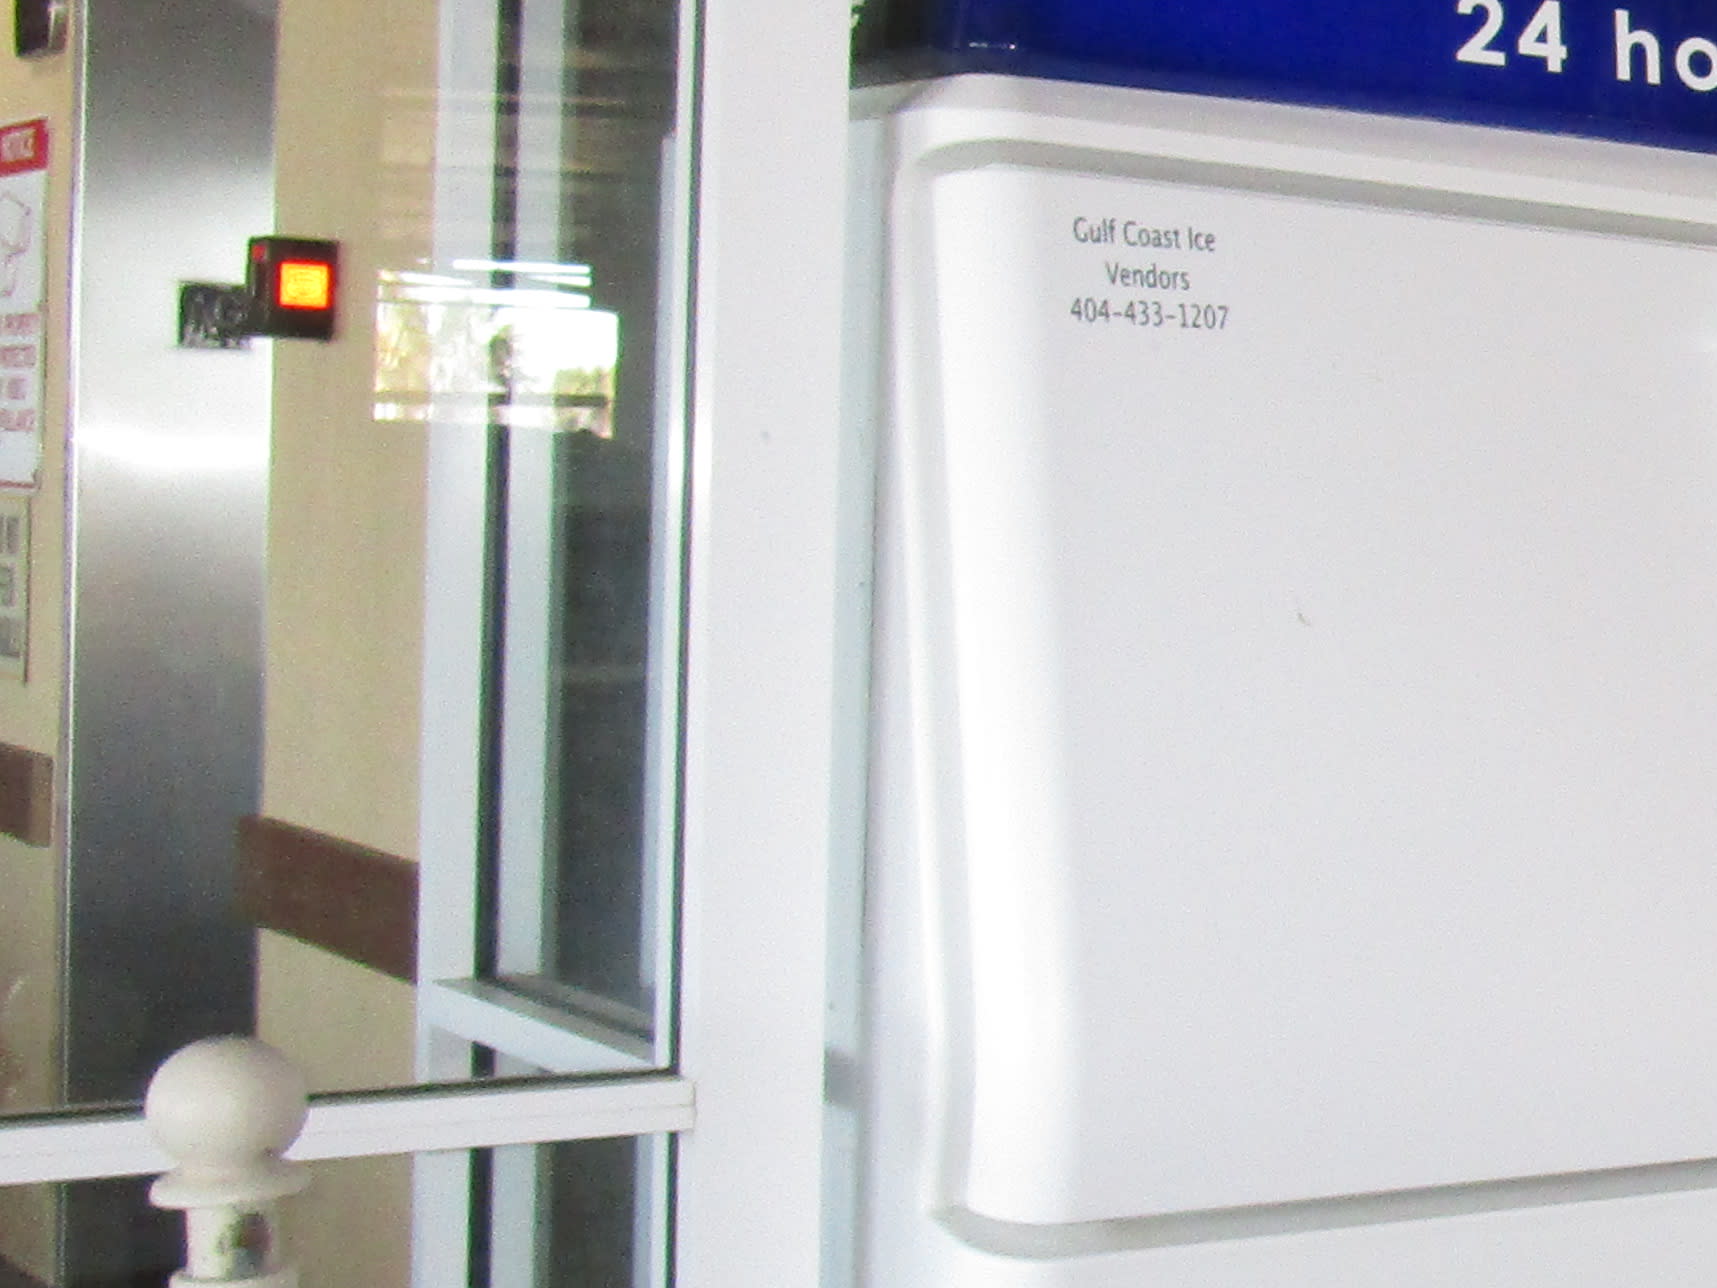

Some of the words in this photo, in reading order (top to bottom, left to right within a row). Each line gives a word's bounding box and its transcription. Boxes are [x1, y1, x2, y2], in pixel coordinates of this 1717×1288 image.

[1073, 216, 1116, 244] Gulf
[1123, 220, 1182, 250] Coast
[1188, 226, 1216, 252] Ice
[1105, 261, 1191, 291] Vendors
[1070, 297, 1230, 330] 404-433-1207
